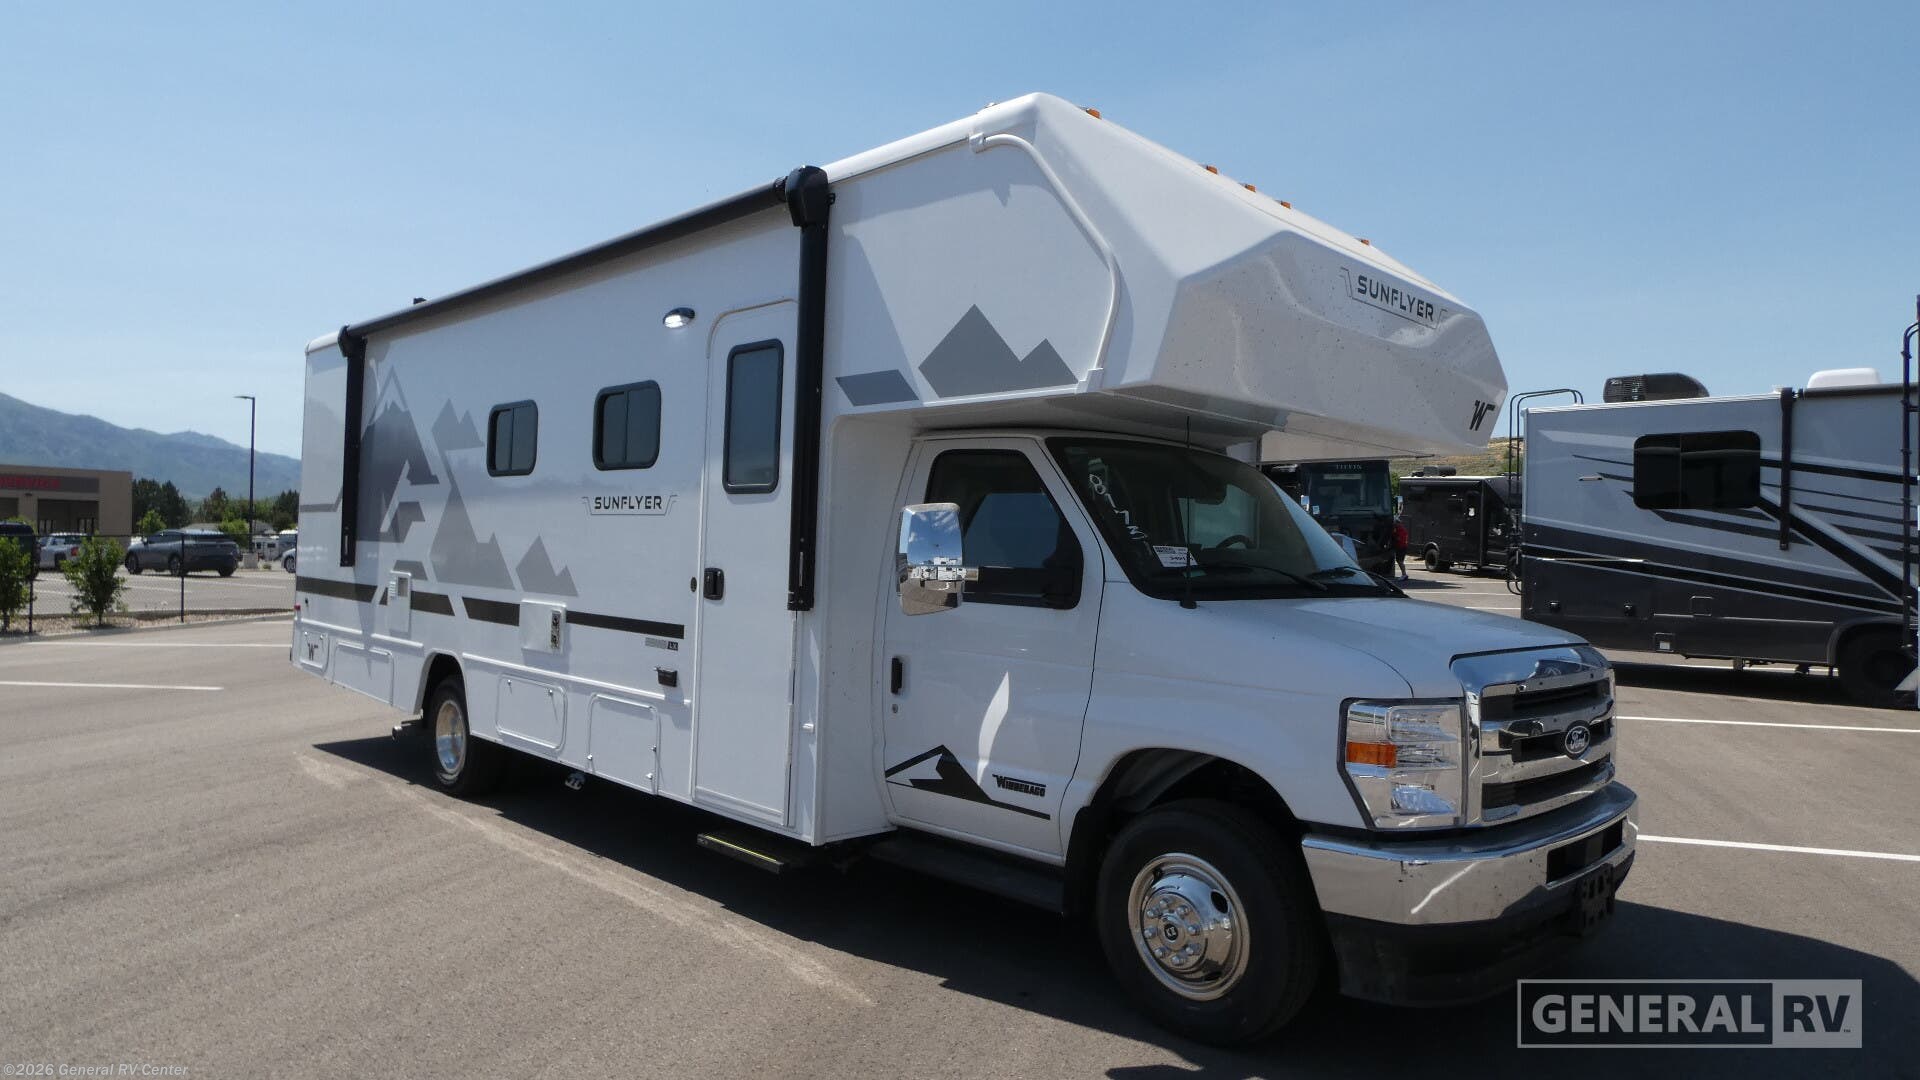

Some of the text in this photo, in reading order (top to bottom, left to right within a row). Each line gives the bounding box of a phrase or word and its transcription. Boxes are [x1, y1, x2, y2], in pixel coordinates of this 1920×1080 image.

[1357, 275, 1434, 322] SUNFLYER
[594, 495, 663, 510] SUNFLYER
[1570, 729, 1586, 750] Ford
